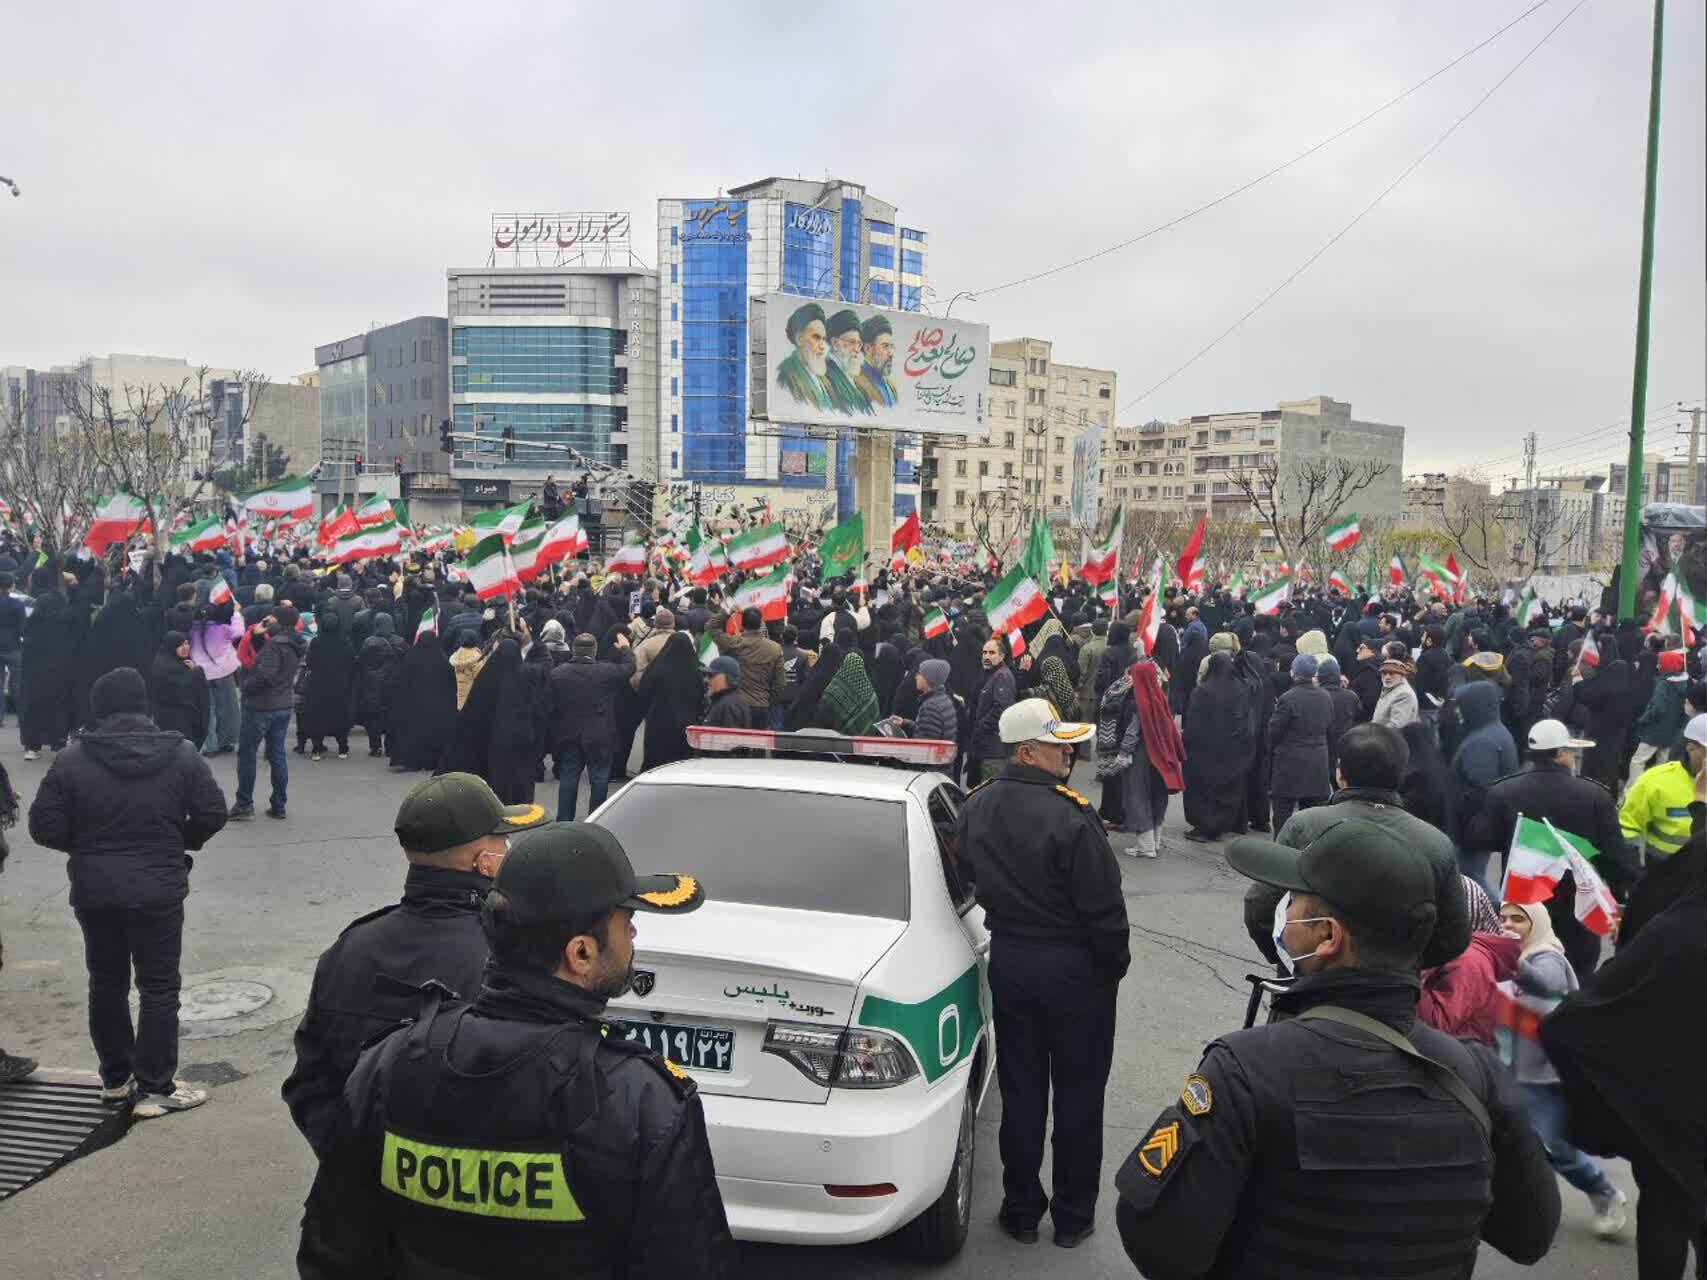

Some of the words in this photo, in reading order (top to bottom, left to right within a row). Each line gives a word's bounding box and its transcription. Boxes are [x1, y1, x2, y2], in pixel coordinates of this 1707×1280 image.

[494, 217, 552, 249] دامون
[556, 212, 630, 248] رستوران
[723, 983, 791, 1006] پلیس
[624, 1027, 690, 1062] ۱۱۹
[696, 1038, 731, 1068] ۲۲
[395, 1146, 555, 1210] POLICE
